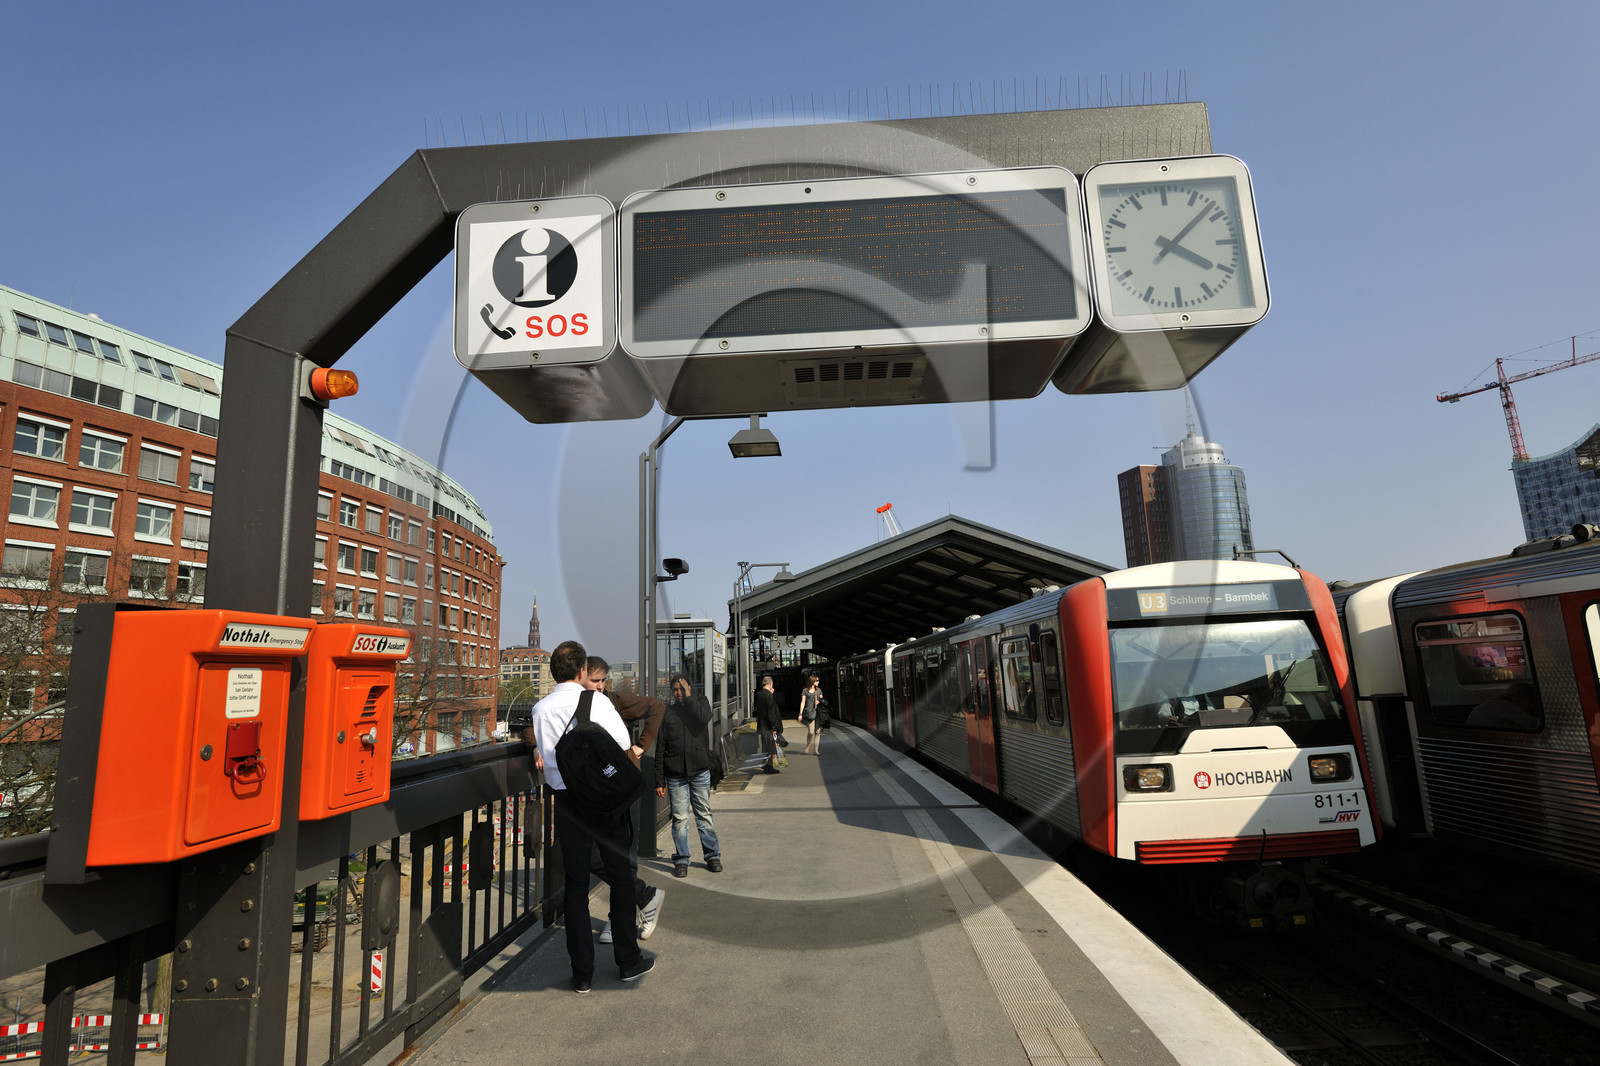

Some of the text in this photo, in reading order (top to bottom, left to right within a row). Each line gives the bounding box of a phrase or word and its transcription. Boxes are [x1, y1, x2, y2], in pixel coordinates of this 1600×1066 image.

[525, 312, 589, 339] SOS
[1169, 595, 1213, 605] Schlump
[1224, 592, 1269, 602] Barmbek
[221, 627, 270, 643] Nothalt
[269, 637, 293, 645] Emergency
[355, 637, 378, 651] SOS
[1215, 768, 1293, 787] HOCHBAHN
[1314, 792, 1360, 808] 811-1
[1338, 812, 1360, 823] HVV
